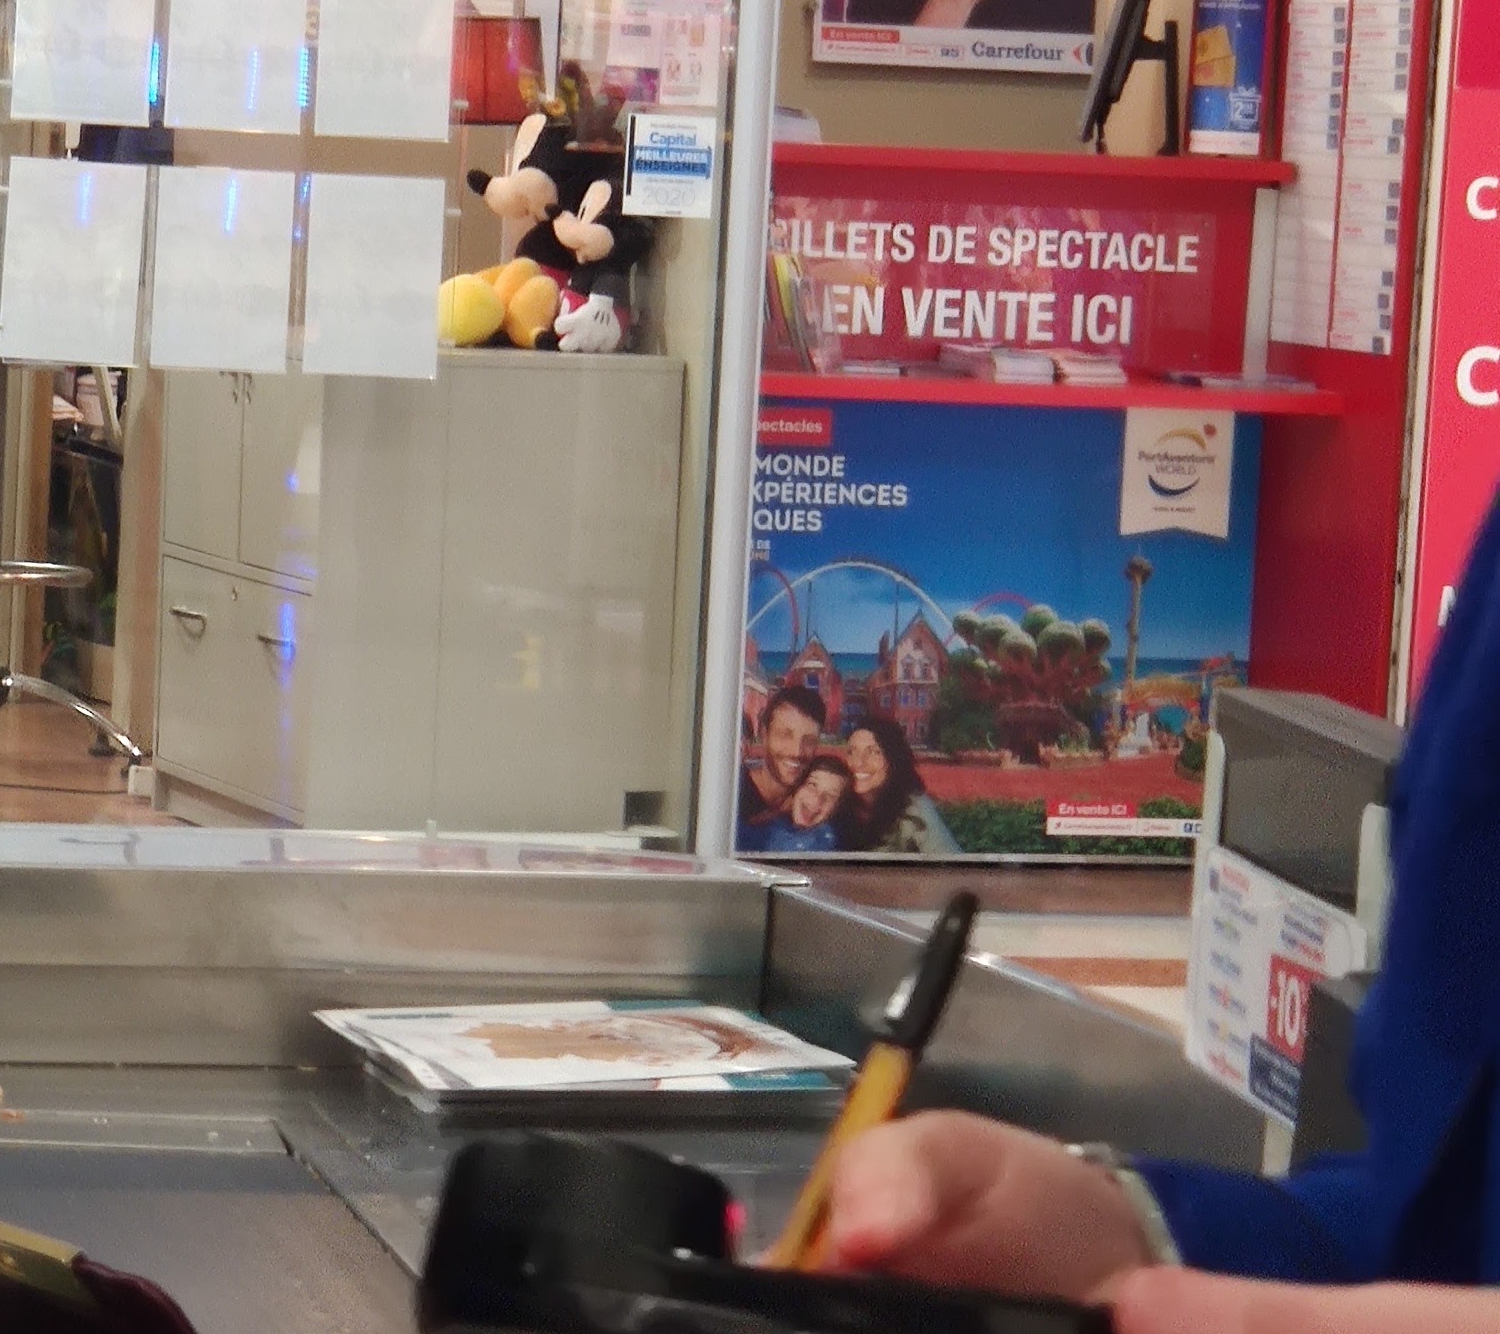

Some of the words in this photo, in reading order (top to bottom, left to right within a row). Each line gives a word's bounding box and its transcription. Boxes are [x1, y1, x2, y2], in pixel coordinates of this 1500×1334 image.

[972, 40, 1065, 61] Carrefour
[650, 132, 697, 148] Capital
[928, 226, 977, 265] DE
[987, 228, 1200, 274] SPECTACLE
[823, 284, 884, 336] EN
[901, 286, 1056, 342] VENTE
[1070, 294, 1133, 345] ICI
[753, 453, 846, 478] MONDE
